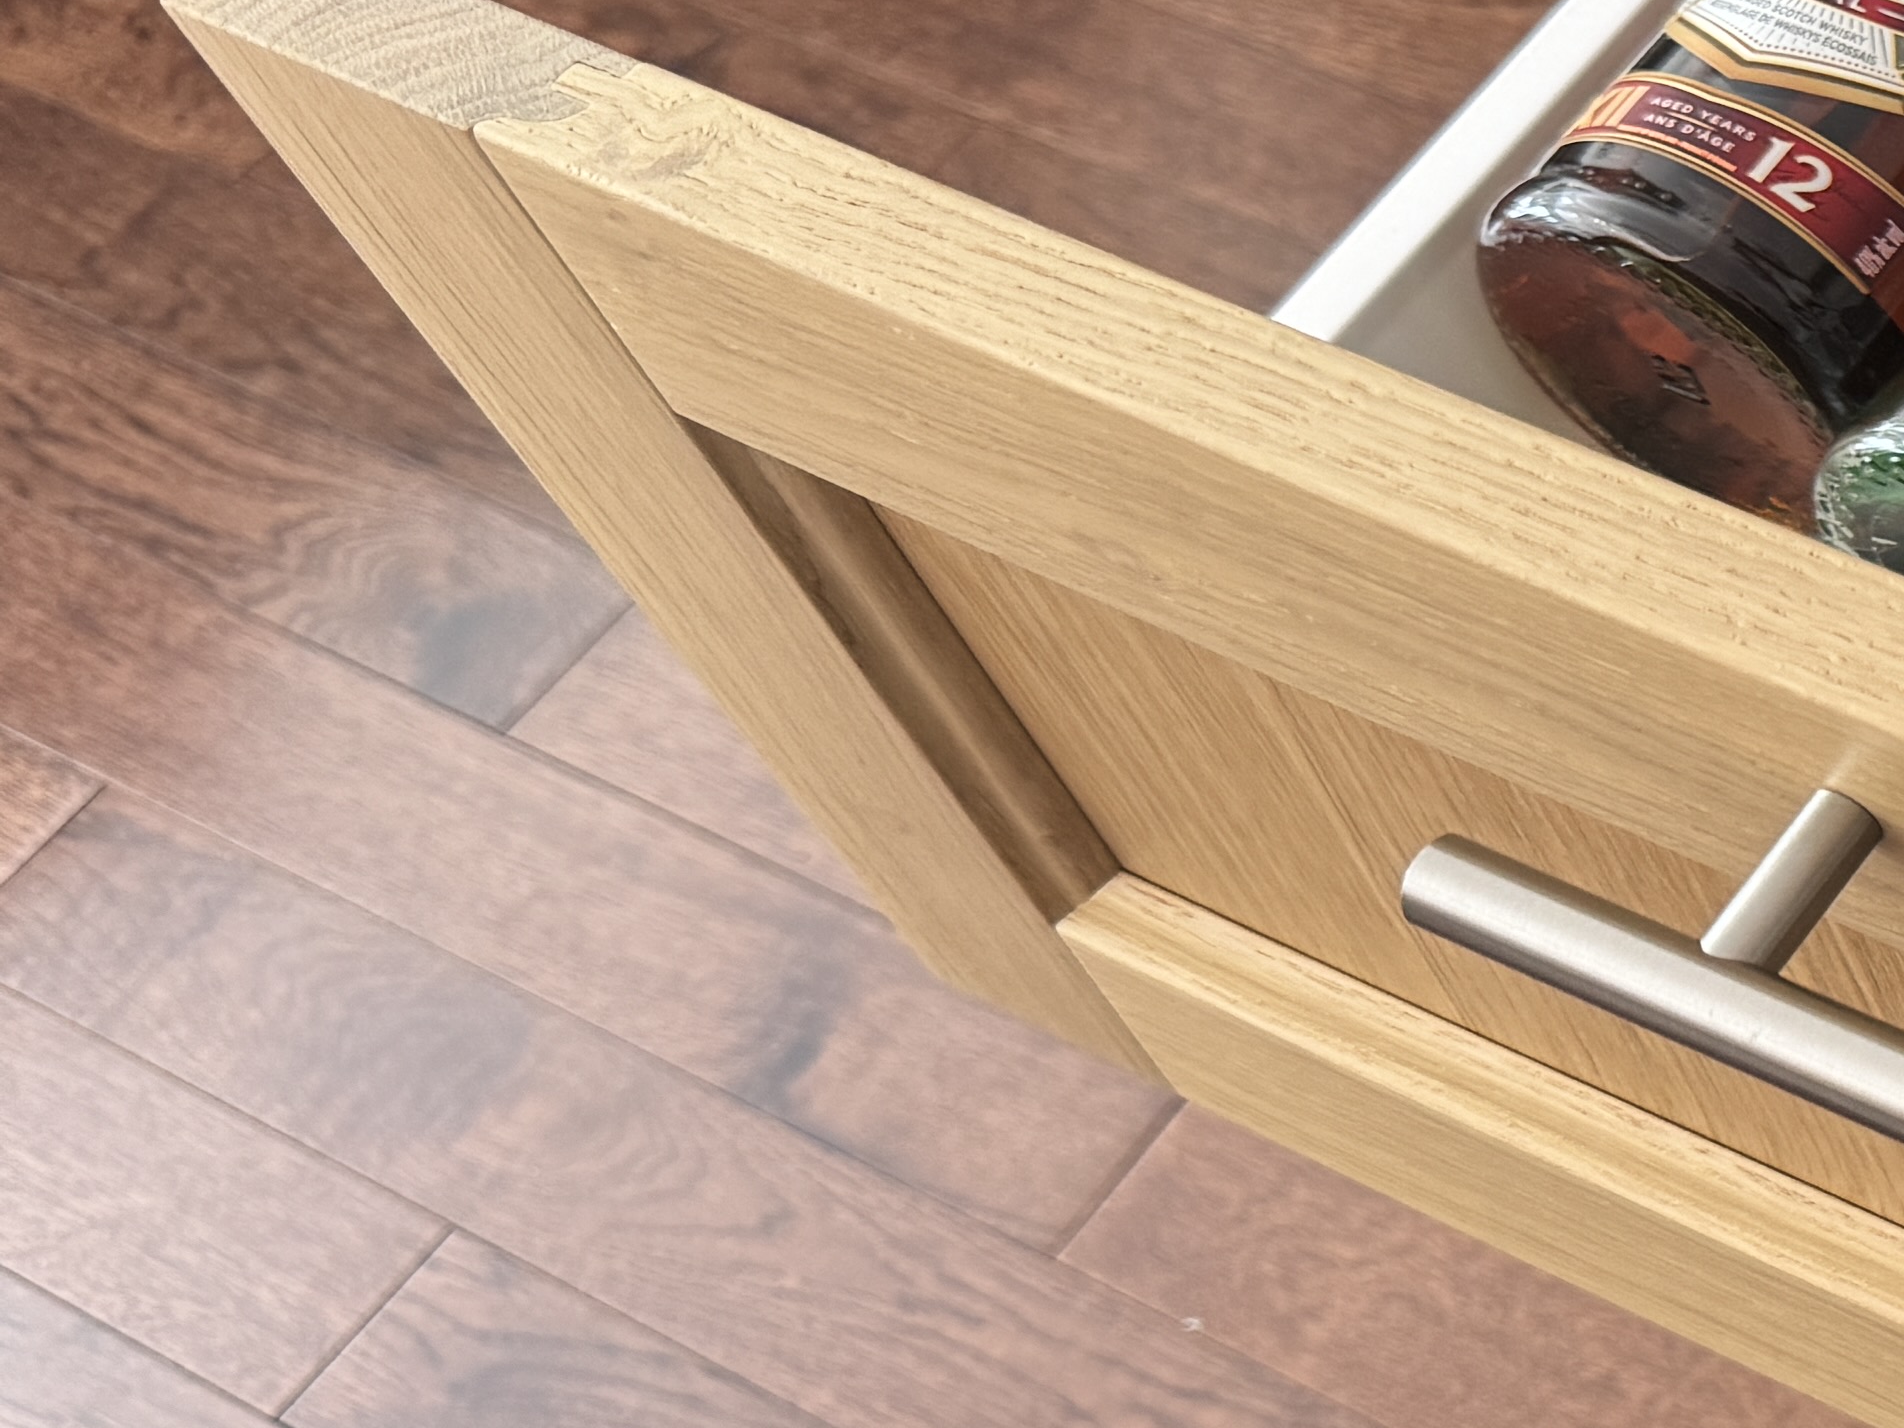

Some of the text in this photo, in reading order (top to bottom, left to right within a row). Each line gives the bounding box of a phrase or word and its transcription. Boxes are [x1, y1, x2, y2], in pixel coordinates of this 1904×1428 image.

[1772, 0, 1817, 27] SCOTCH
[1818, 17, 1870, 46] WHISKY
[1820, 35, 1879, 66] ÉCOSSAIS
[1643, 113, 1676, 129] ANS
[1650, 95, 1757, 143] AGED YEARS
[1746, 135, 1834, 214] 12
